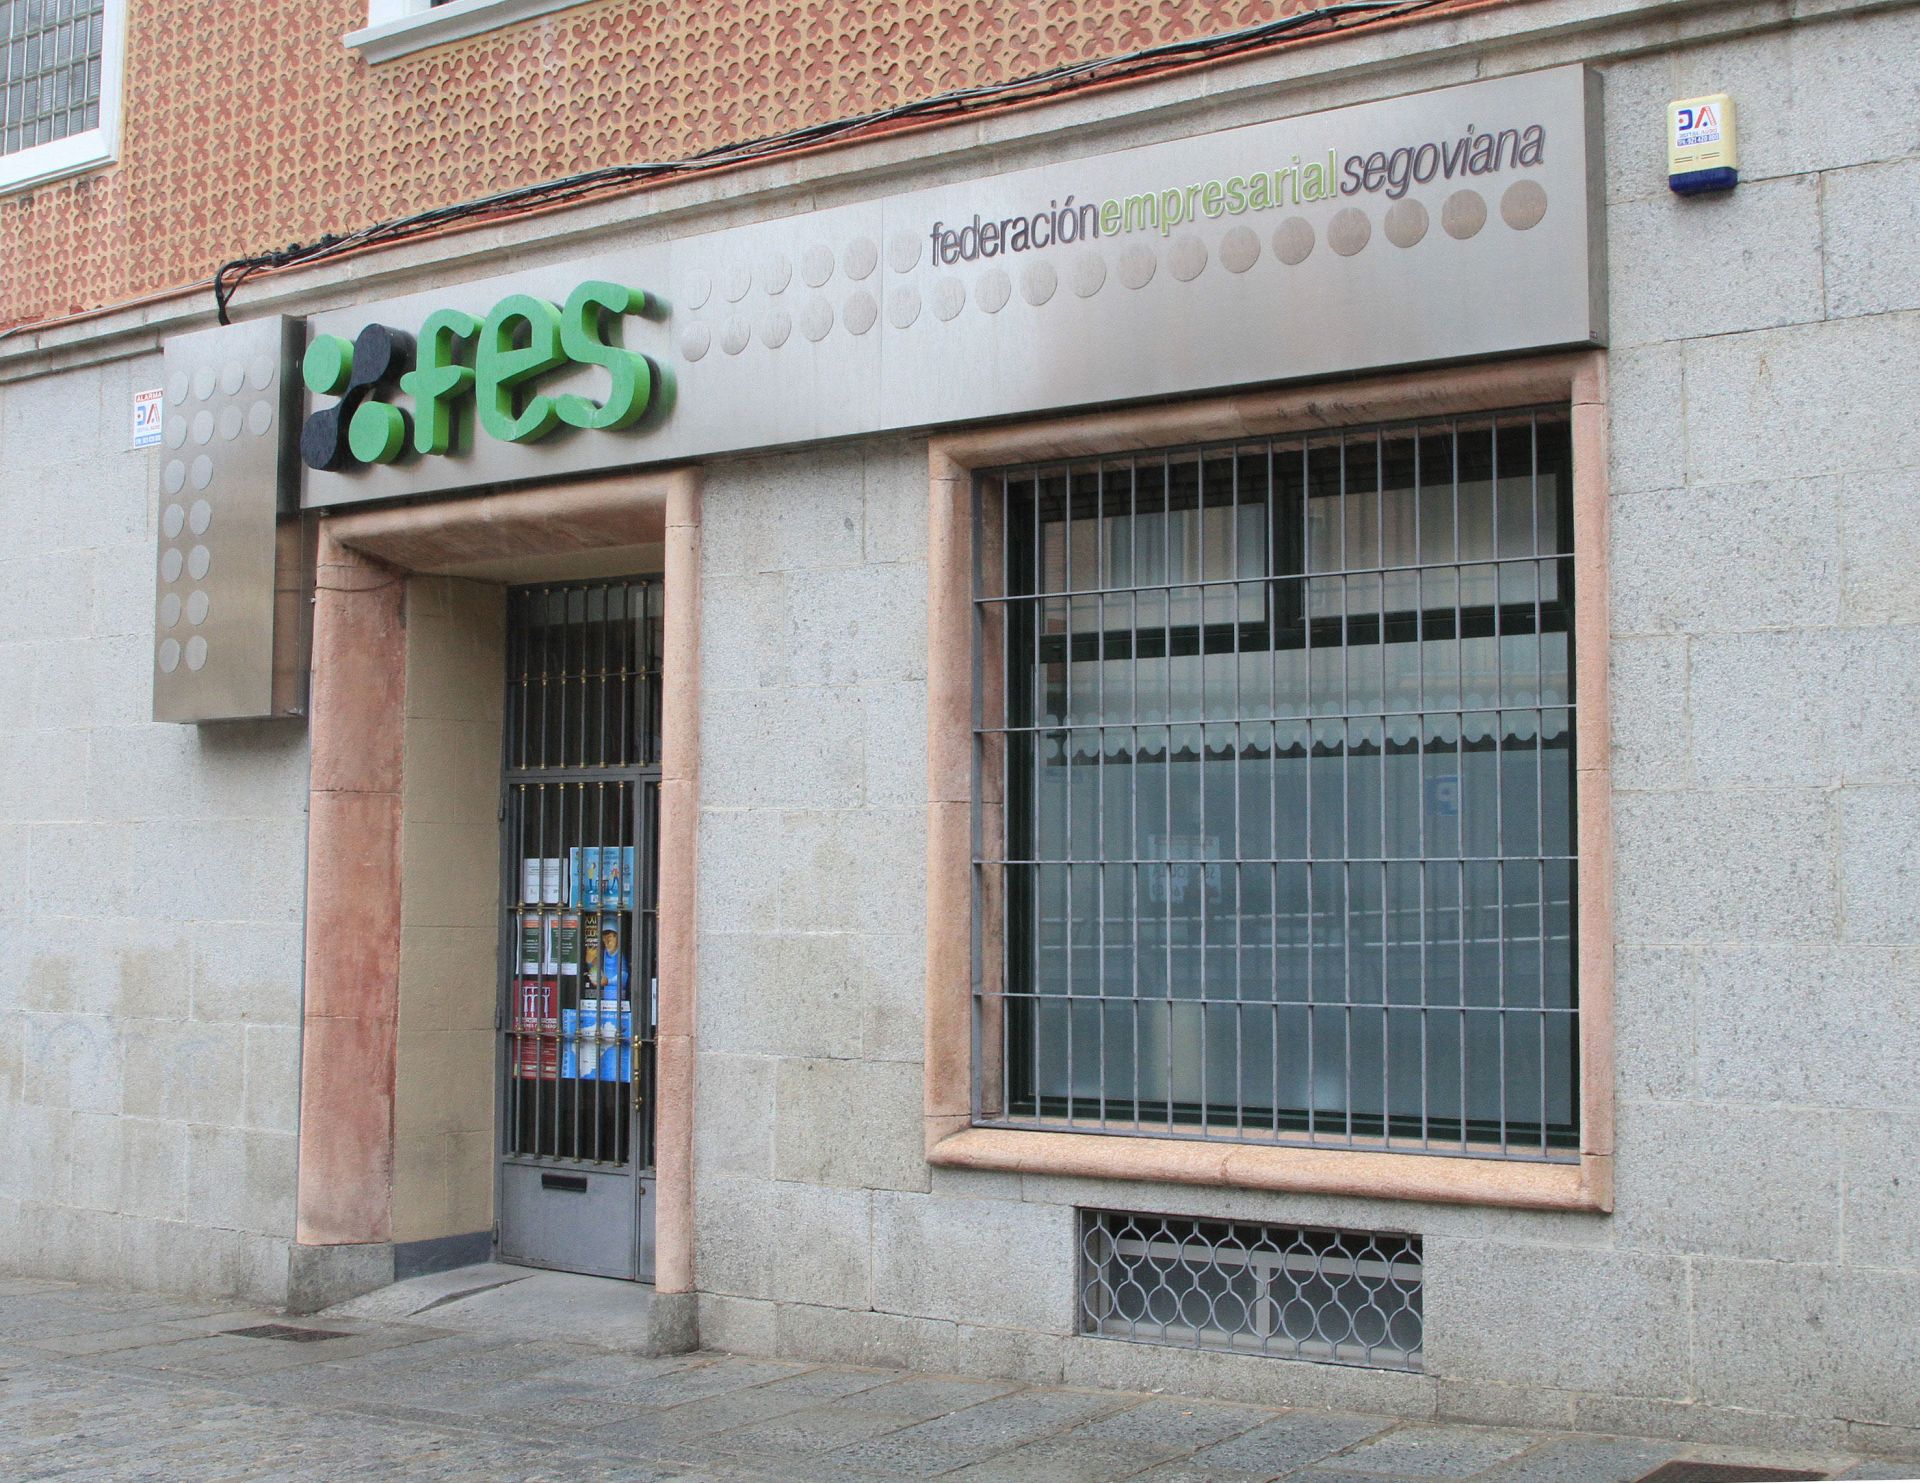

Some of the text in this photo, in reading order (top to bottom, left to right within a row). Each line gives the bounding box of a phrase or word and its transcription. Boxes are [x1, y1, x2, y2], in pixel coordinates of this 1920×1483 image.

[929, 122, 1546, 267] federación empresarial segoviana
[136, 391, 162, 402] ALARMA
[399, 280, 651, 455] fes
